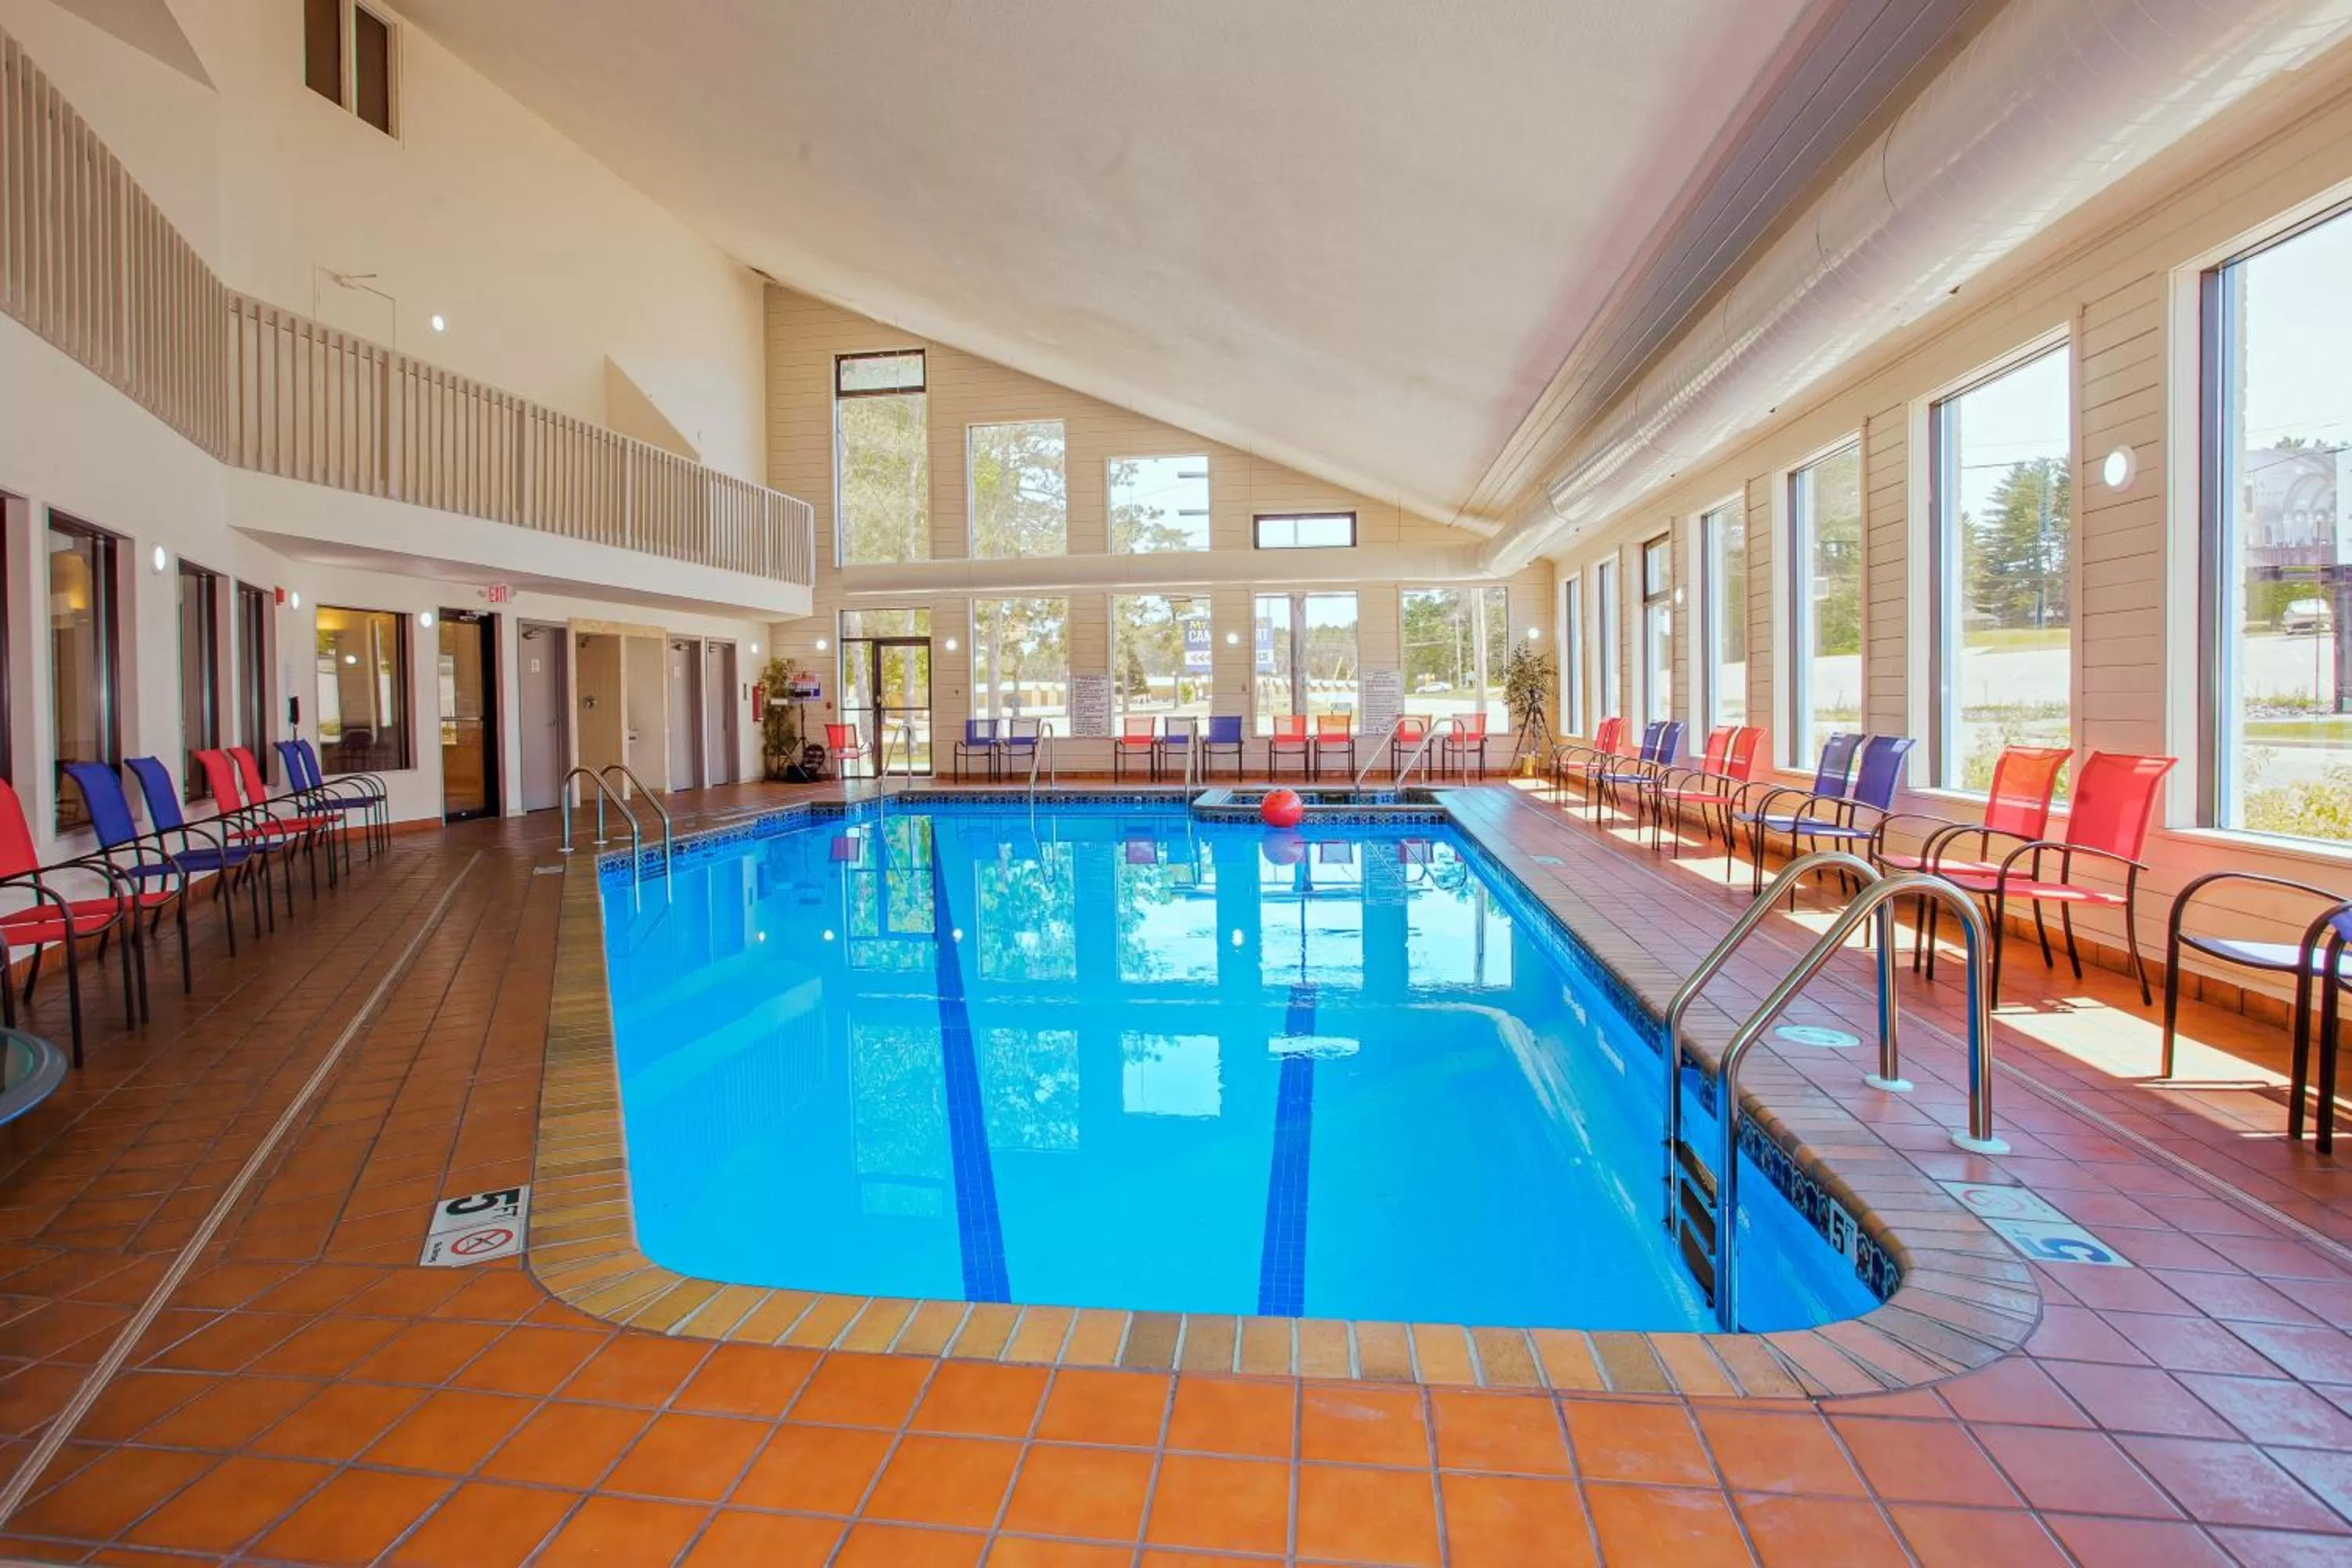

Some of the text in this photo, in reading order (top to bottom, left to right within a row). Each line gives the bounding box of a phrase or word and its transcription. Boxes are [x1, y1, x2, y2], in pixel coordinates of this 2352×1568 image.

[488, 586, 507, 603] EXIT
[445, 1188, 521, 1215] 5
[1833, 1209, 1845, 1255] 5
[2014, 1236, 2111, 1263] 5
